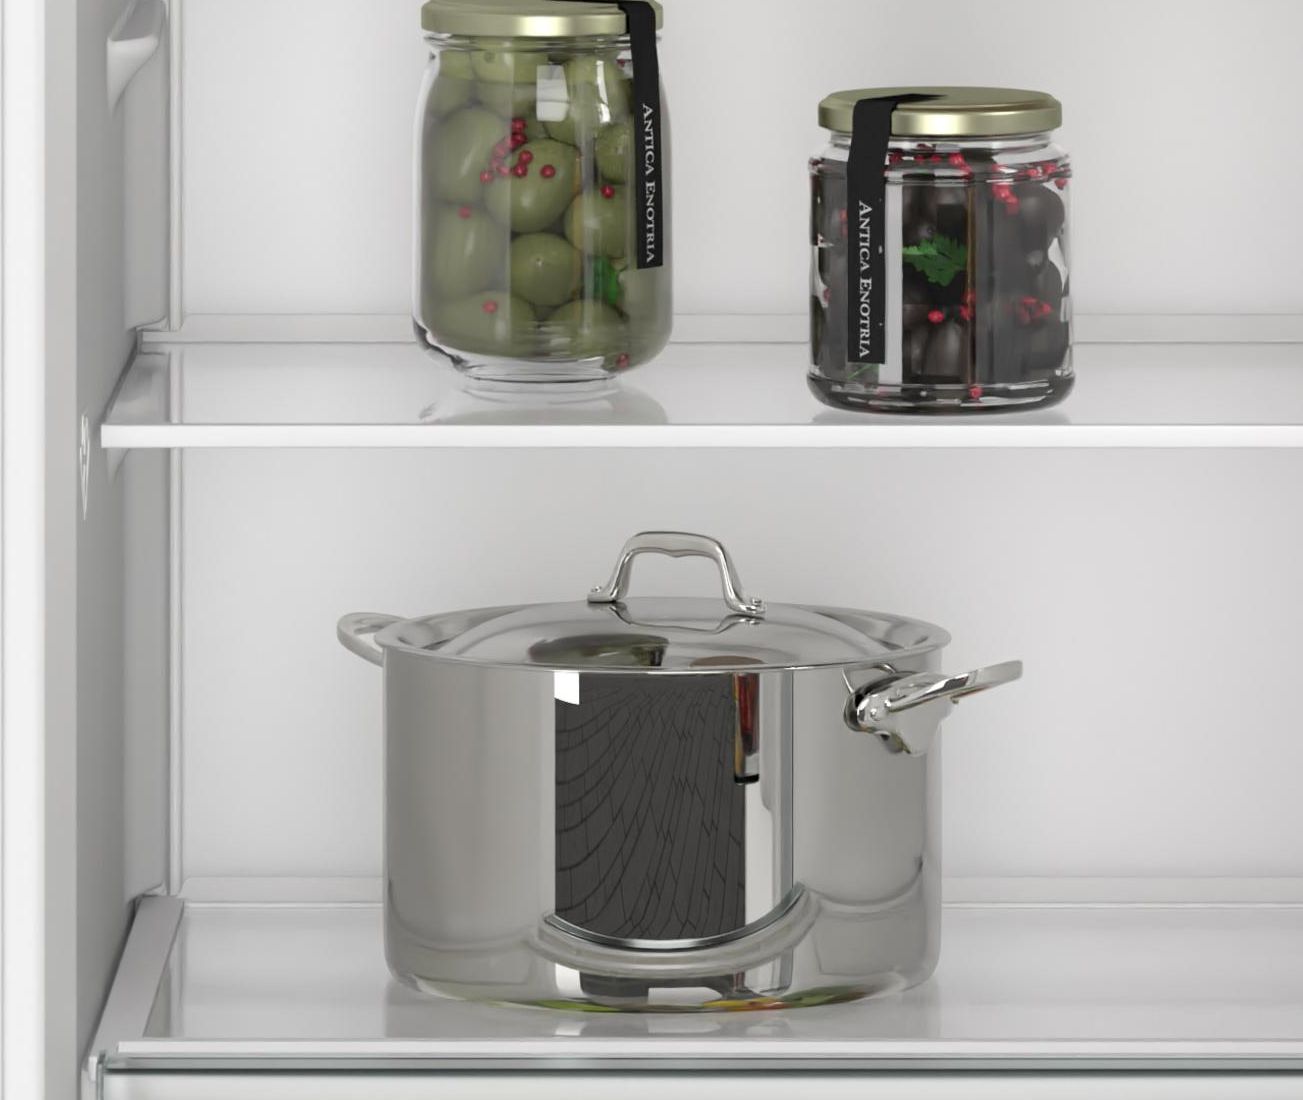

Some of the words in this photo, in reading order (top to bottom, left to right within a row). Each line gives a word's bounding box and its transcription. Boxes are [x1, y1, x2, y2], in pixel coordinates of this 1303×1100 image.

[642, 103, 656, 176] ANTICA
[645, 181, 656, 264] ENOTRIA
[858, 200, 873, 273] ANTICA
[858, 276, 873, 359] ENOTRIA
